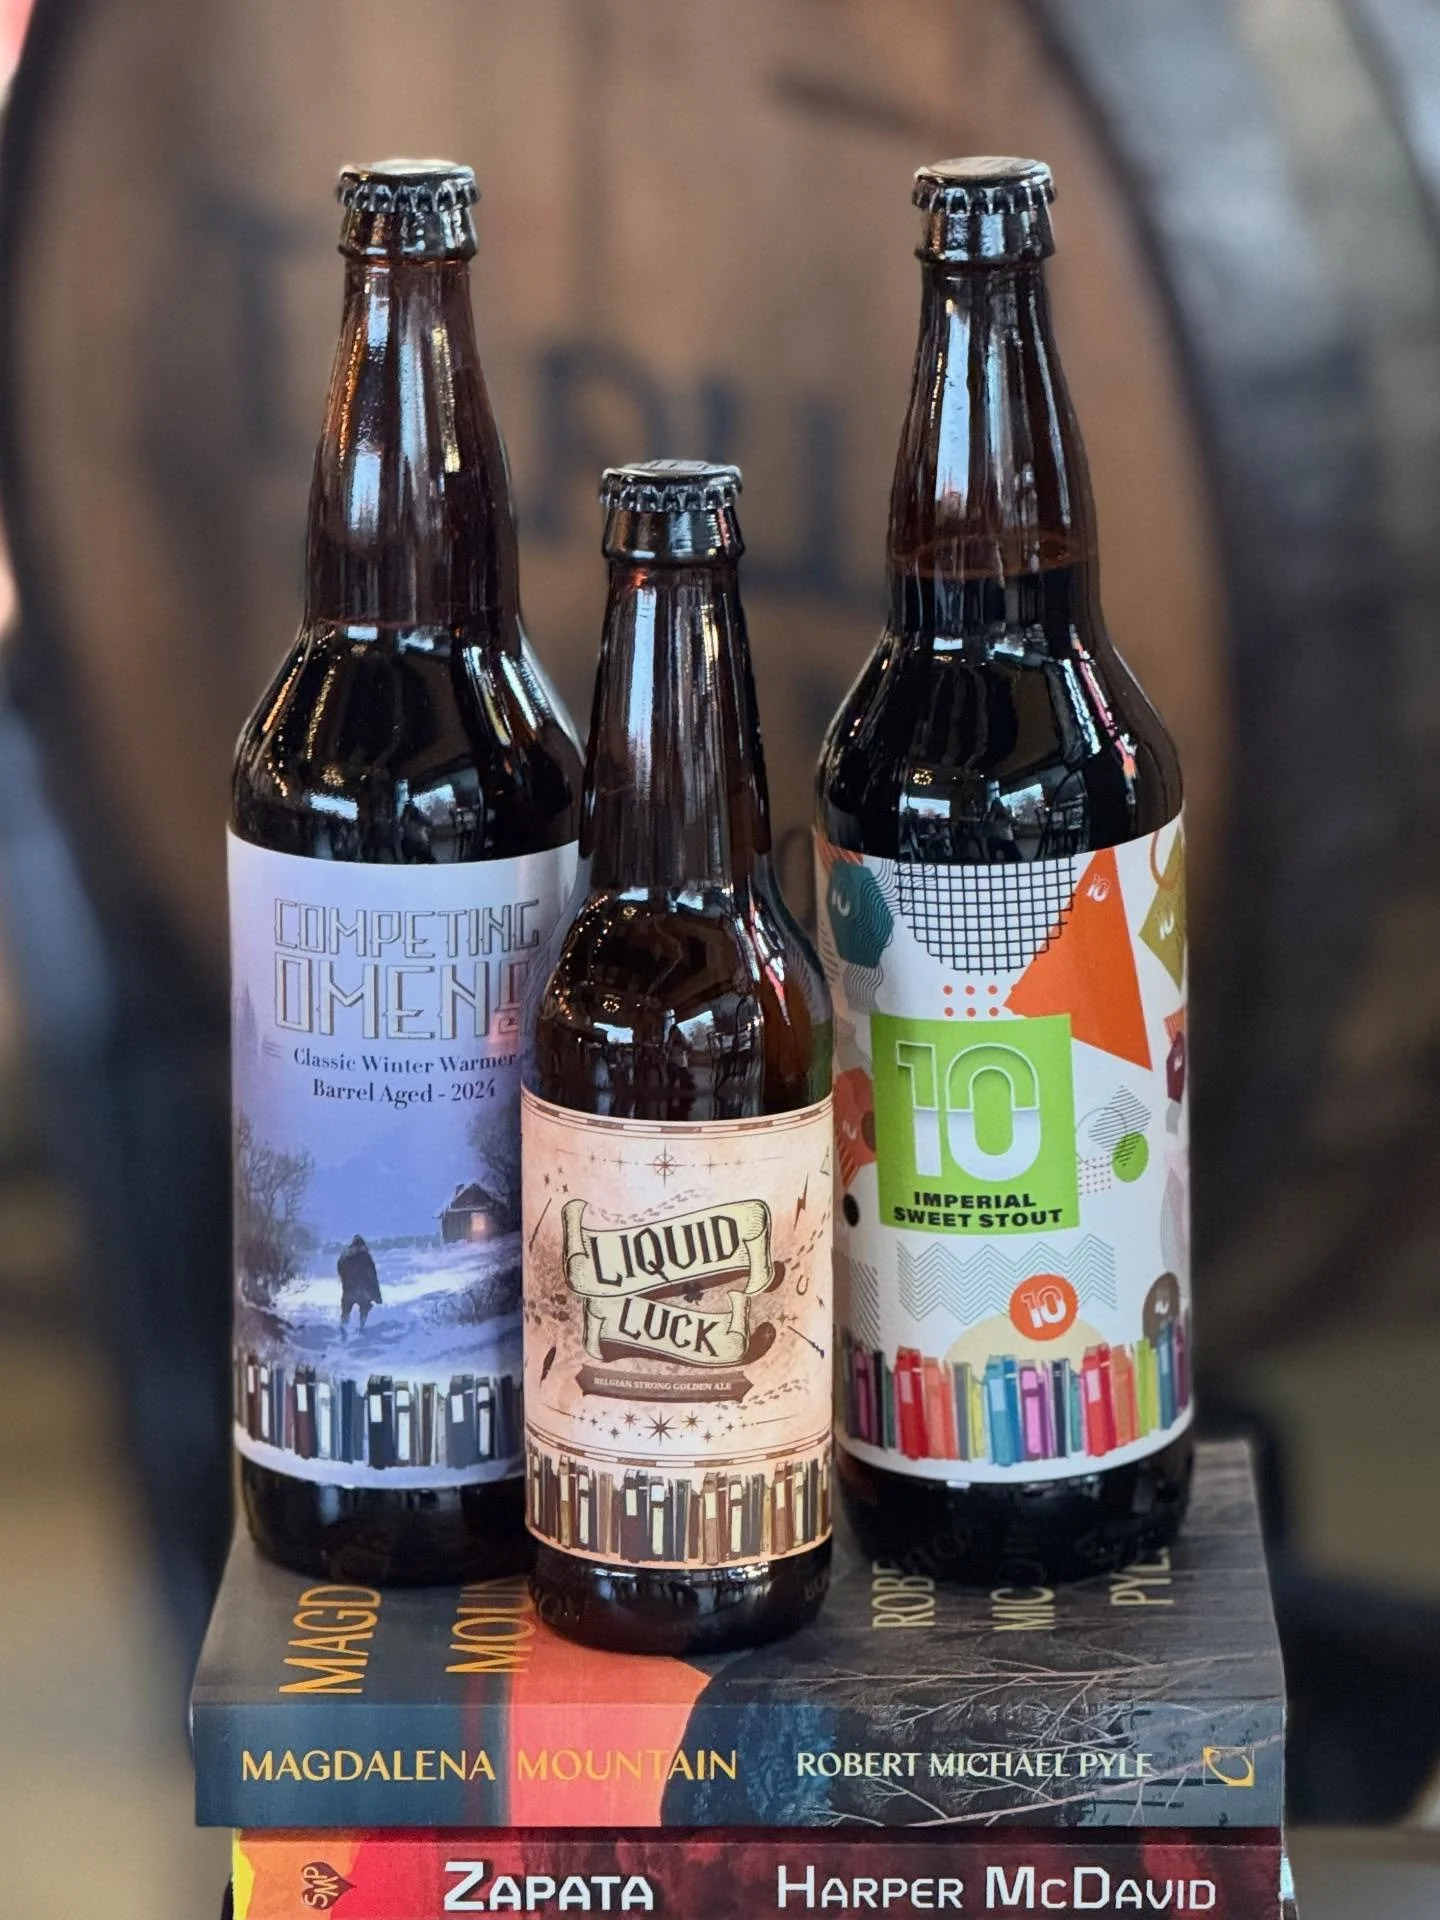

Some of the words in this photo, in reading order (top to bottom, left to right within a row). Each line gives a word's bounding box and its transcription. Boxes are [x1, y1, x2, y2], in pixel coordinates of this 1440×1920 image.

[274, 898, 539, 958] COMPETING
[293, 1047, 356, 1072] Classic
[361, 1055, 434, 1074] Winter
[439, 1054, 516, 1073] Warmer
[313, 1078, 374, 1101] Barrel
[380, 1083, 433, 1110] Aged
[450, 1078, 496, 1101] 2024
[896, 1040, 1041, 1182] 10
[914, 1191, 1037, 1209] IMPERIAL
[893, 1206, 972, 1228] SWEET
[978, 1208, 1063, 1228] STOUT
[589, 1214, 741, 1288] LIQUID
[1020, 1284, 1068, 1329] 10
[617, 1297, 720, 1358] LUCK
[593, 1376, 633, 1389] BELGIAN
[634, 1379, 671, 1391] STRONG
[673, 1381, 712, 1391] GOLDEN
[713, 1381, 732, 1391] ALE
[241, 1750, 497, 1782] MAGDALENA
[516, 1749, 738, 1782] MOUNTAIN
[797, 1753, 917, 1778] ROBERT
[928, 1752, 1070, 1778] MICHAEL
[1079, 1752, 1154, 1778] PYLE
[443, 1861, 654, 1911] ZAPATA
